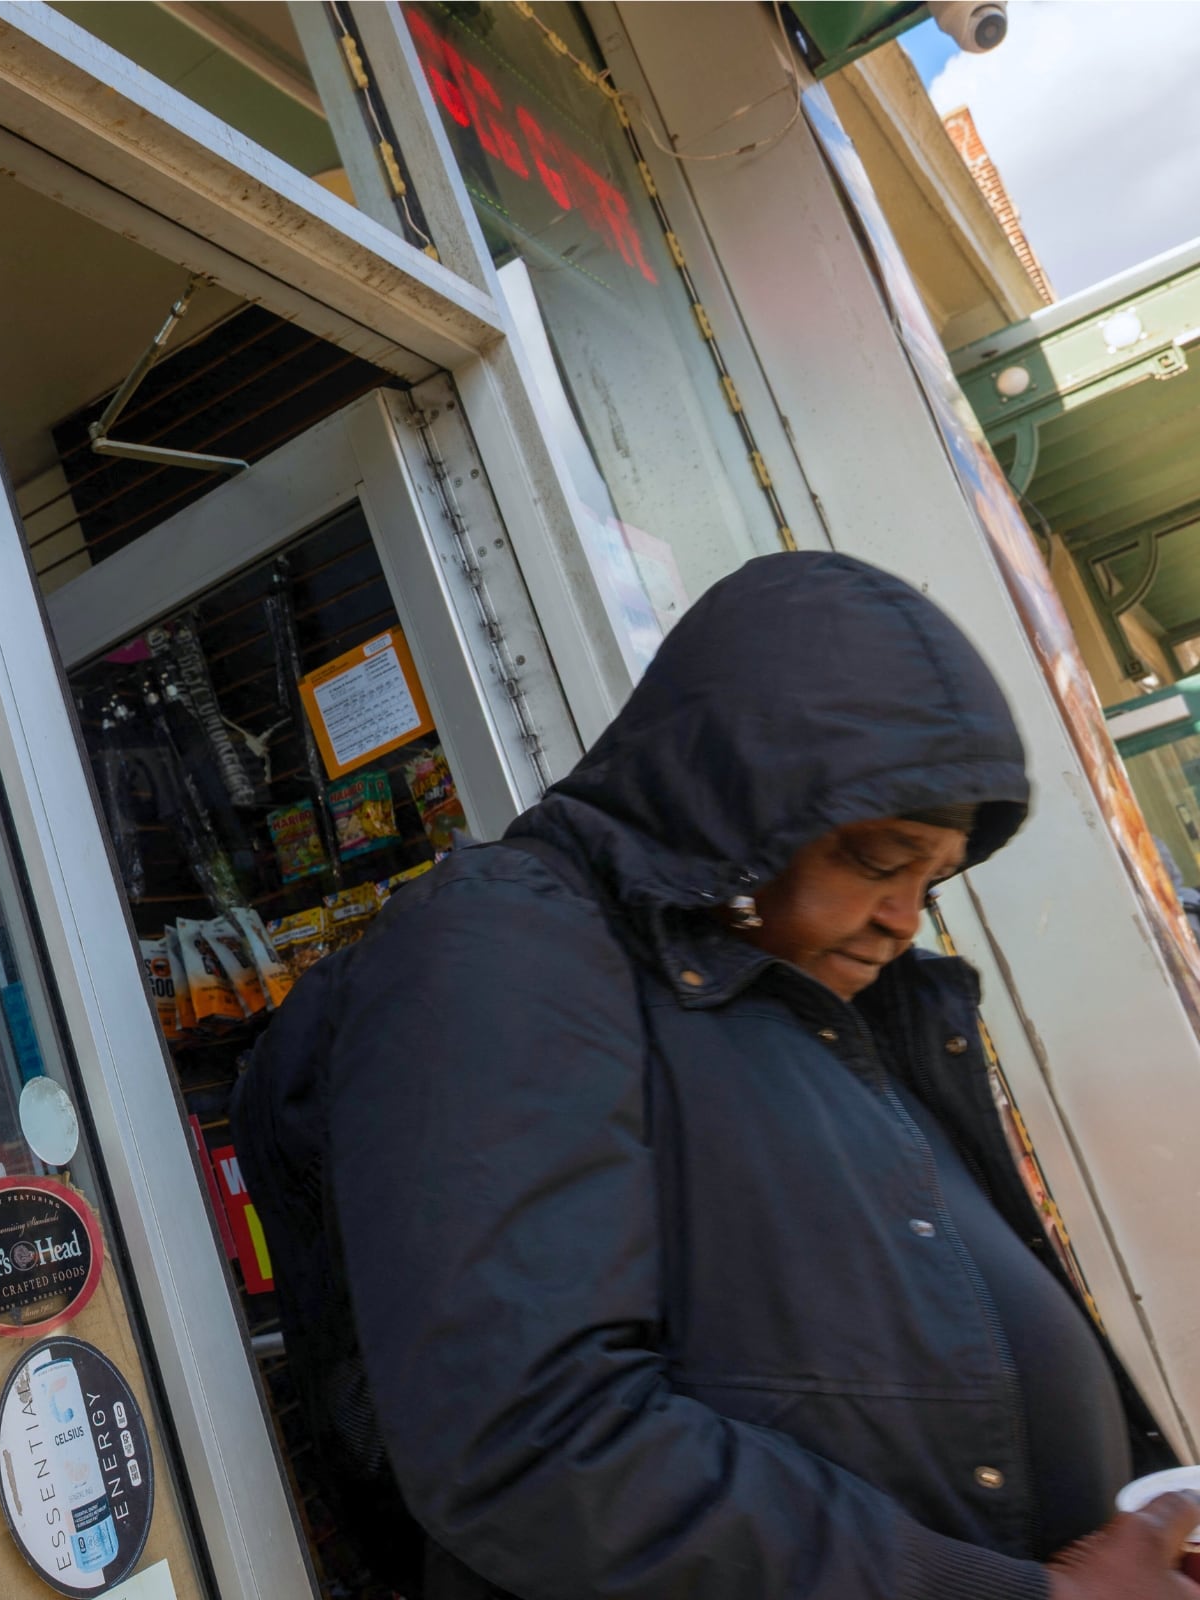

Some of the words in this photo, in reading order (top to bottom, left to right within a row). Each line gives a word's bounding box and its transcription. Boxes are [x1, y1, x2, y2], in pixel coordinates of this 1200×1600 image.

[272, 810, 313, 831] HARIBO
[7, 1194, 60, 1209] FEATURING
[34, 1229, 82, 1265] Head
[2, 1276, 49, 1297] CRAFTED
[52, 1265, 86, 1283] FOODS
[54, 1426, 85, 1447] CELSIUS
[86, 1392, 129, 1520] ENERGY
[17, 1377, 72, 1571] ESSENTIAL
